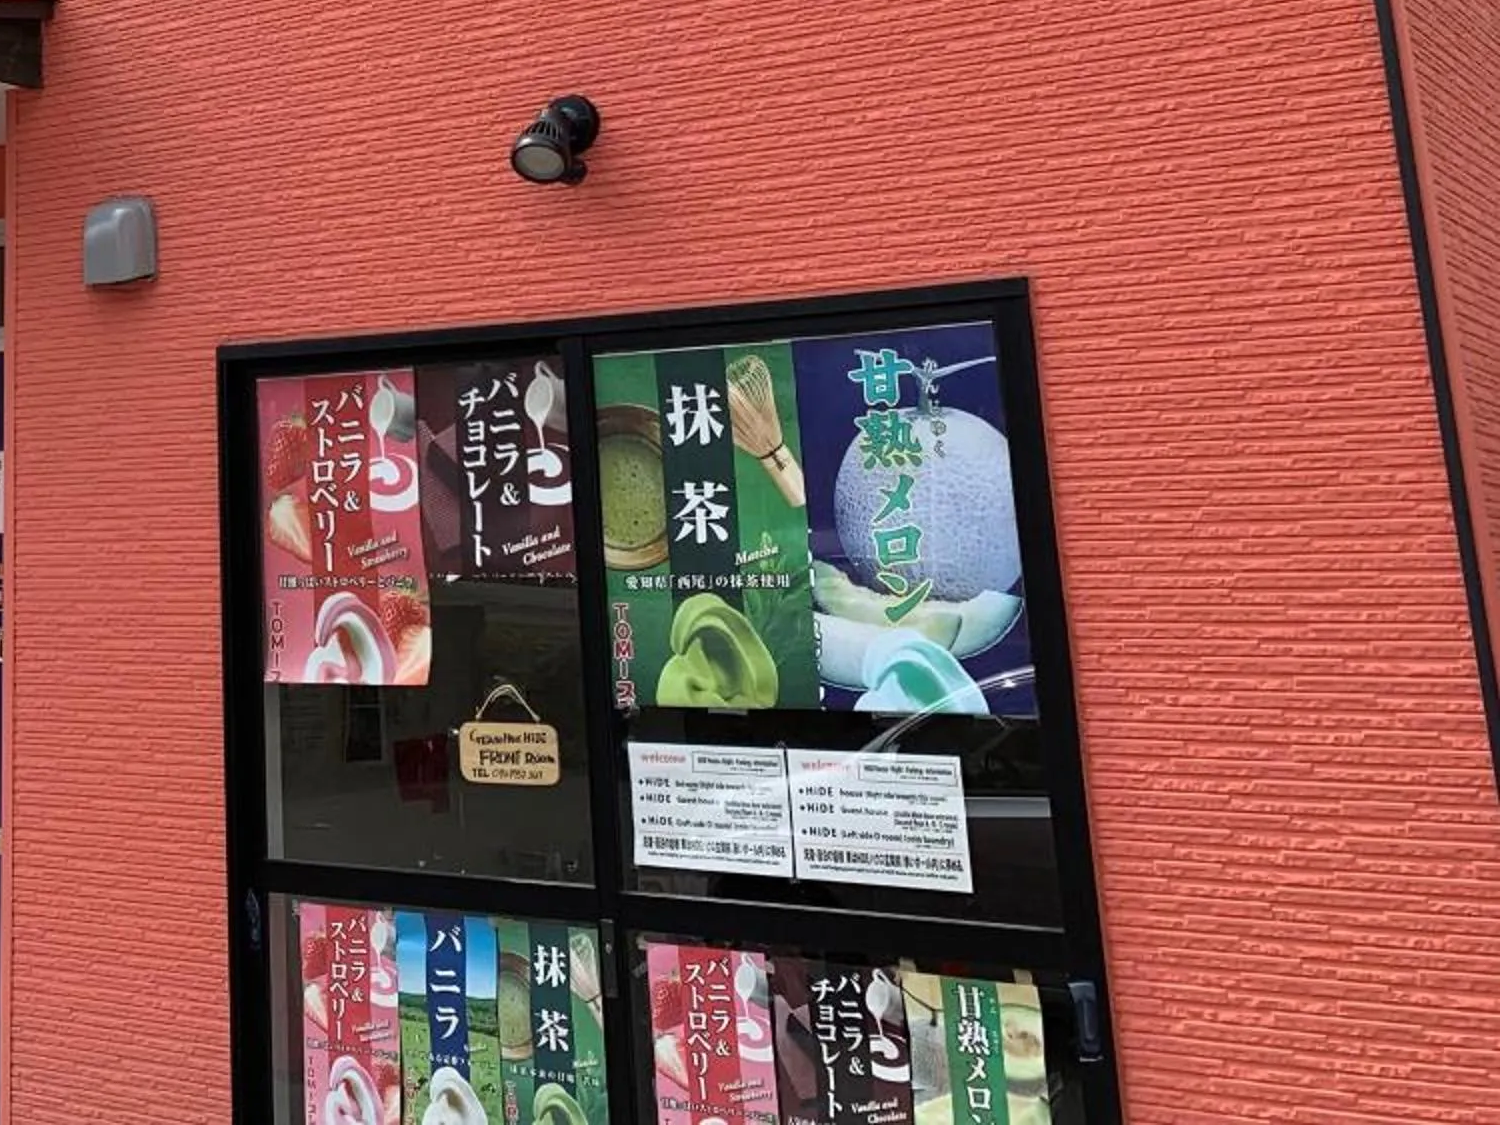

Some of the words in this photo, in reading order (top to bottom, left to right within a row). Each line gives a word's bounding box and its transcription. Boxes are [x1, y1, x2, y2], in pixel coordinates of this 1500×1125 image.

[308, 397, 341, 574] ストロベリー
[458, 387, 493, 568] チョコレート
[665, 382, 731, 545] 抹茶
[848, 348, 932, 626] 甘熟メロン
[501, 535, 539, 556] Vanilla
[540, 524, 561, 543] and
[328, 921, 350, 1042] ストロベリー
[429, 926, 462, 1041] バニラ
[533, 944, 570, 1054] 抹茶
[684, 963, 713, 1102] ストロベリー
[810, 977, 843, 1119] チョコレート
[955, 983, 992, 1125] 甘熟メロ
